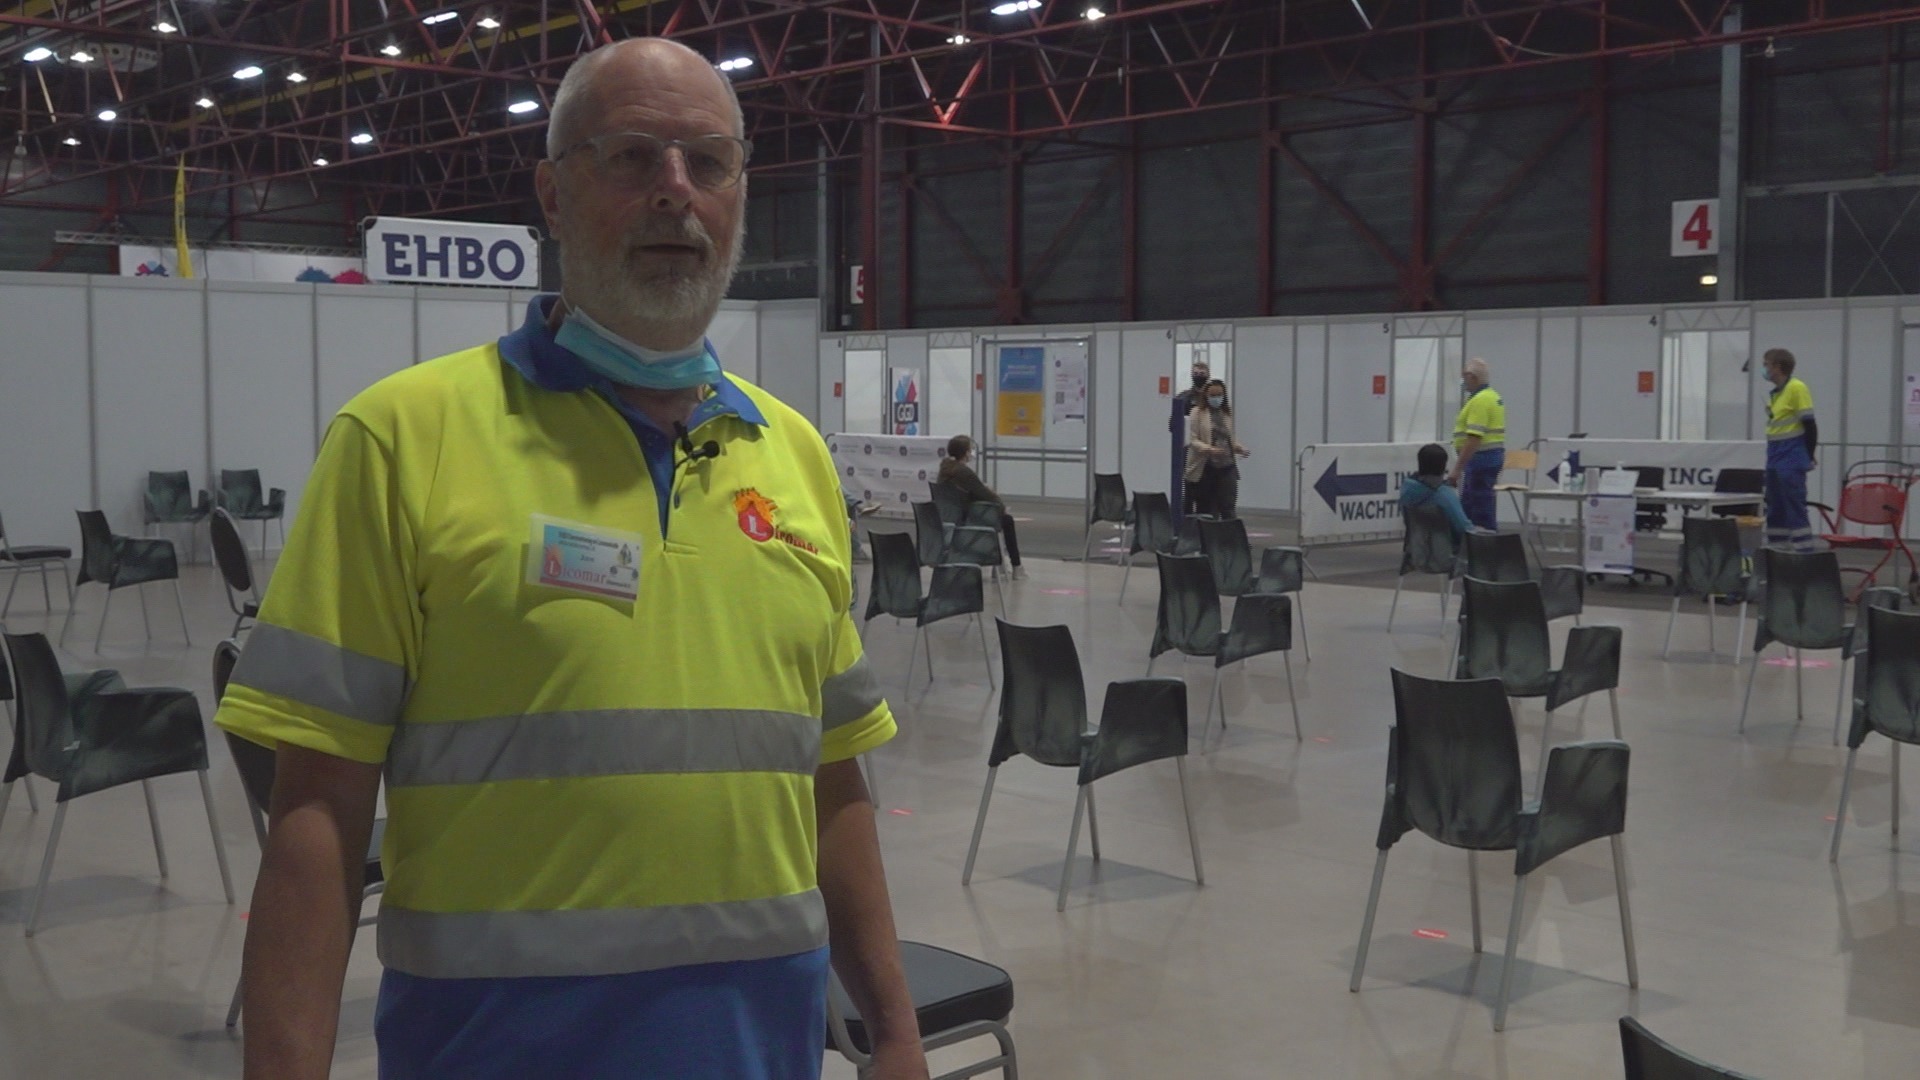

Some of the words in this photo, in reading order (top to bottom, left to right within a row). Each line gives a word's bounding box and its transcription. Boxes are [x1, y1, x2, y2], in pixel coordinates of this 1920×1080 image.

[1682, 204, 1712, 250] 4
[381, 232, 525, 281] EHBO
[1383, 322, 1390, 334] 5
